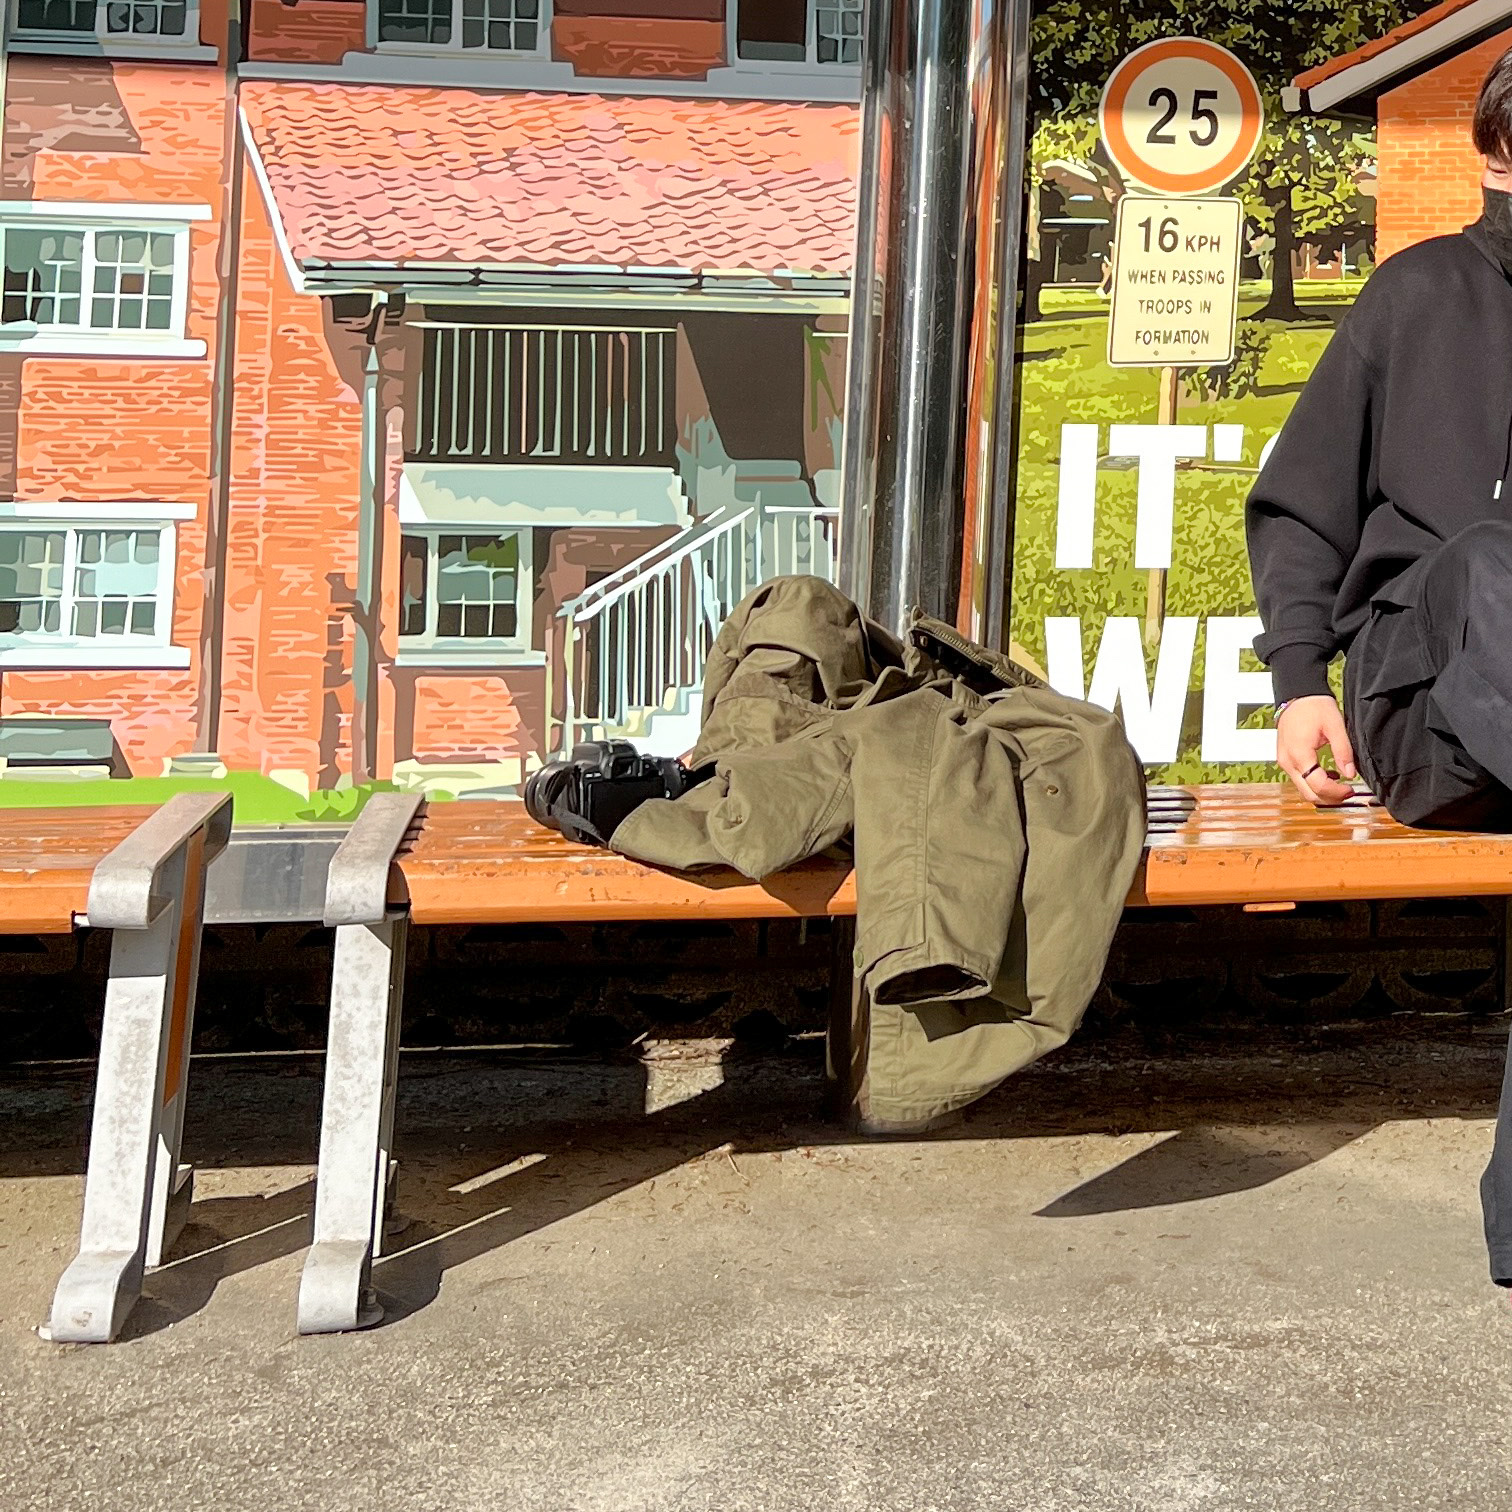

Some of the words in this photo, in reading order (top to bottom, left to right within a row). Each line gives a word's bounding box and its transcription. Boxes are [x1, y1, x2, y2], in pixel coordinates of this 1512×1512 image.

[1146, 87, 1219, 147] 25
[1137, 216, 1180, 254] 16
[1185, 234, 1221, 253] KPH
[1128, 269, 1167, 285] WHEN
[1172, 270, 1225, 286] PASSING
[1138, 299, 1193, 315] TROOPS
[1199, 300, 1212, 315] IN
[1134, 329, 1210, 346] FORMATION
[1055, 423, 1284, 569] IT'
